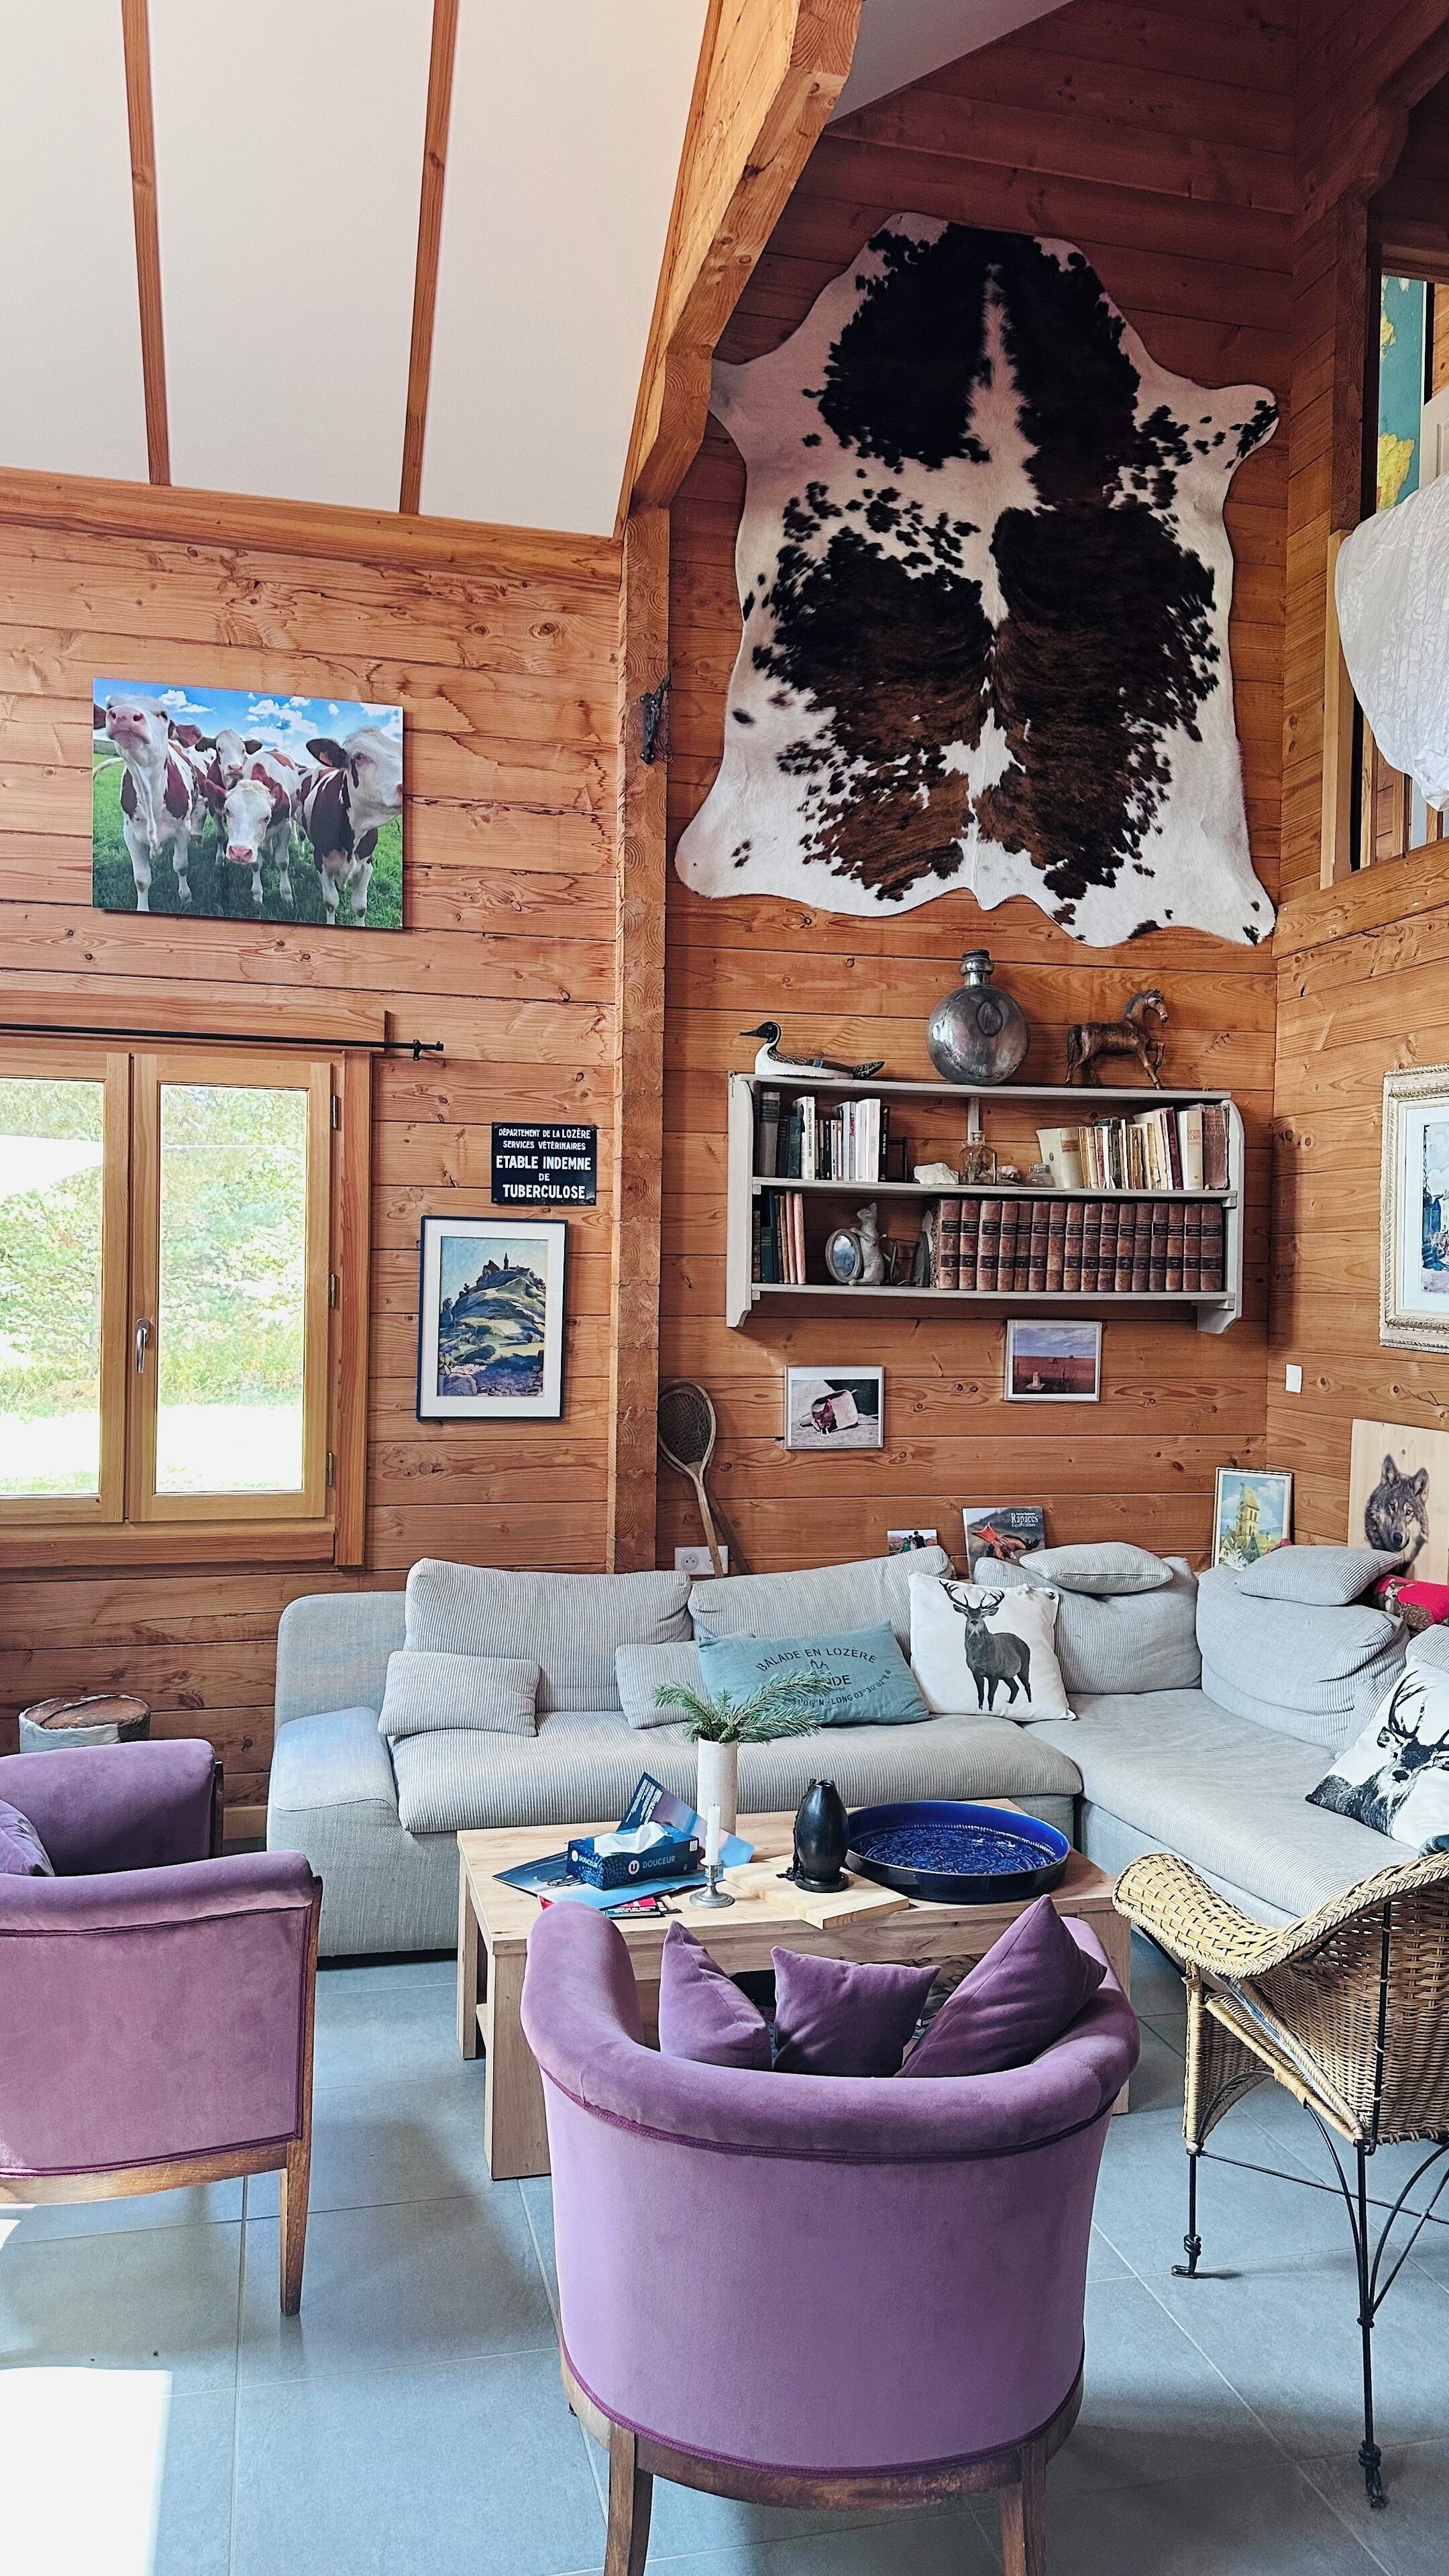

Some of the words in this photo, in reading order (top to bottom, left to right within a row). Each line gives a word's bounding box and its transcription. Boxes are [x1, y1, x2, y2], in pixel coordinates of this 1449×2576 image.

[498, 1128, 540, 1137] DÉPARTEMENT
[561, 1128, 591, 1139] LOZÈRE
[503, 1140, 535, 1148] SERVICES
[538, 1141, 586, 1150] VÉTÉRINAIRES
[496, 1155, 539, 1169] ETABLE
[543, 1156, 591, 1171] INDEMNE
[539, 1173, 550, 1181] DE
[502, 1184, 586, 1199] TUBERCULOSE
[1011, 1512, 1038, 1526] Rapaces
[756, 1650, 802, 1672] BALADE
[805, 1648, 822, 1657] EN
[826, 1647, 877, 1664] LOZÈRE
[826, 1674, 852, 1686] NDE
[631, 1864, 637, 1872] U
[642, 1856, 676, 1869] DOUCEUR
